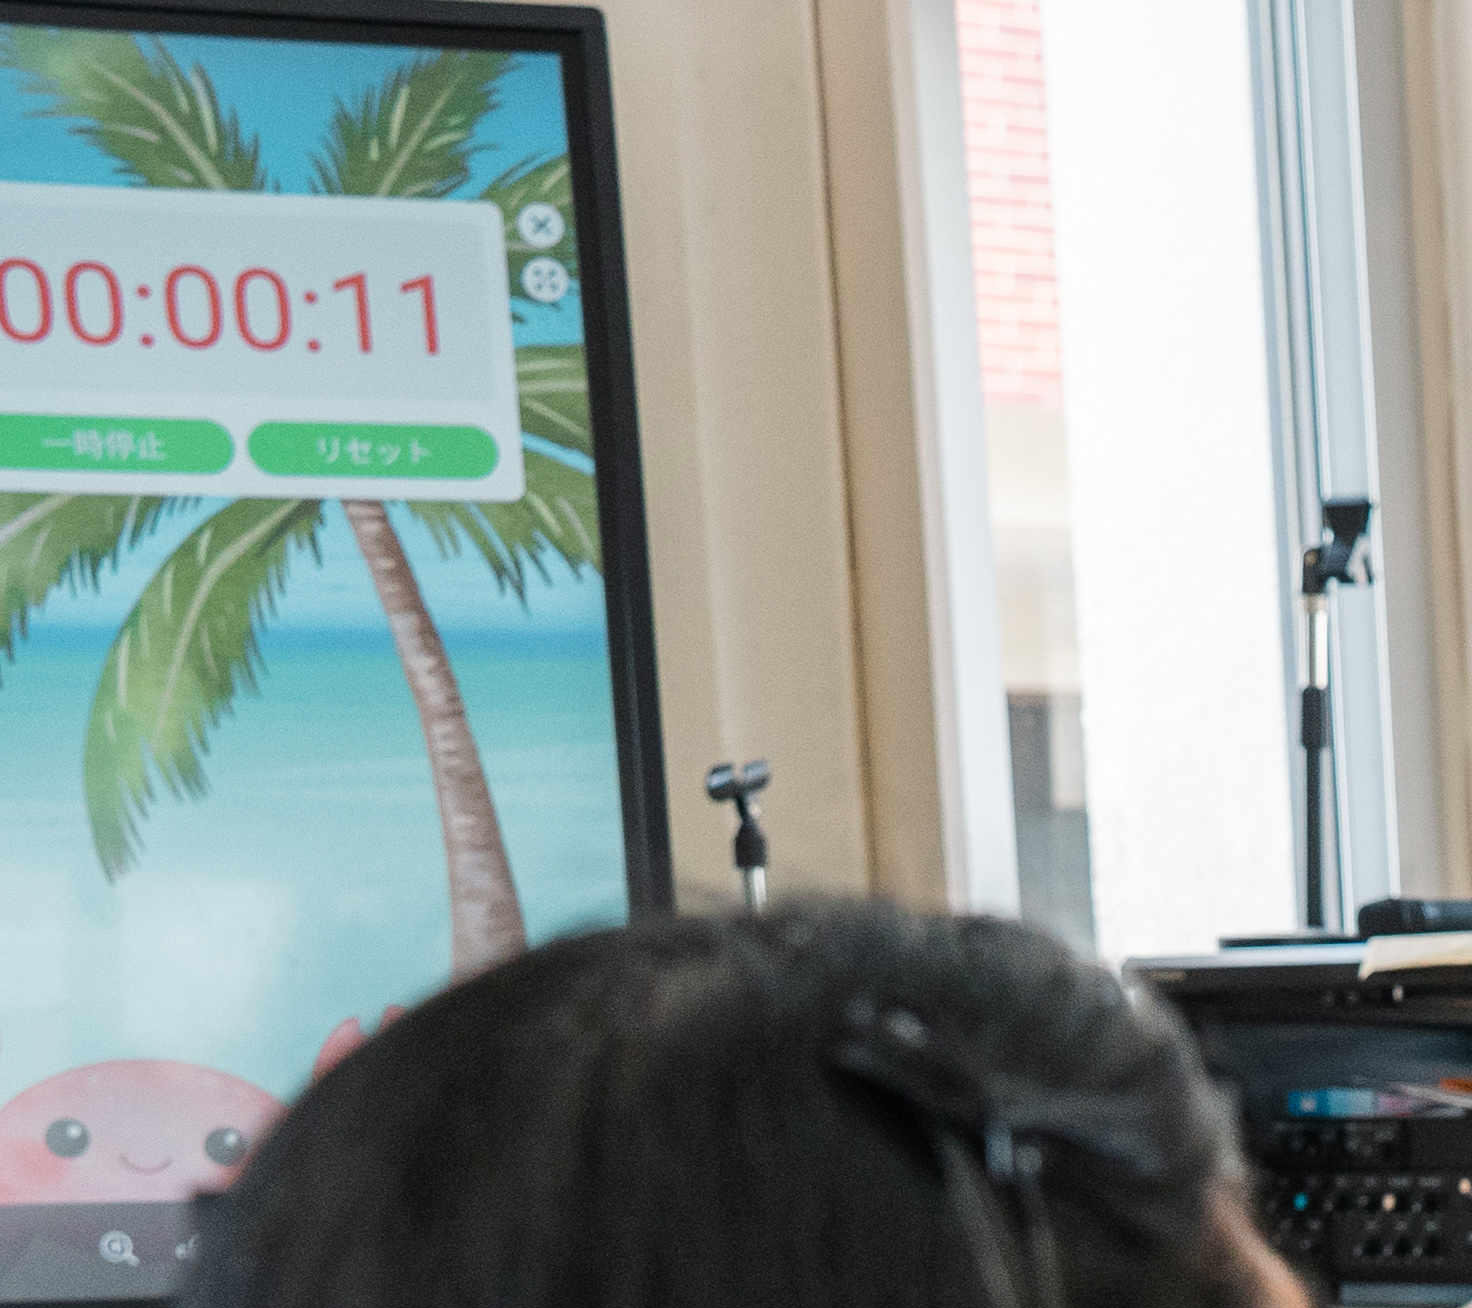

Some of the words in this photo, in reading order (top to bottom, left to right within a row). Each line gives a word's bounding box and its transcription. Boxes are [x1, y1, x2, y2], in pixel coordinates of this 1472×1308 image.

[0, 257, 440, 356] 00:00:11
[43, 426, 167, 463] 一時停止
[317, 437, 430, 466] リセット
